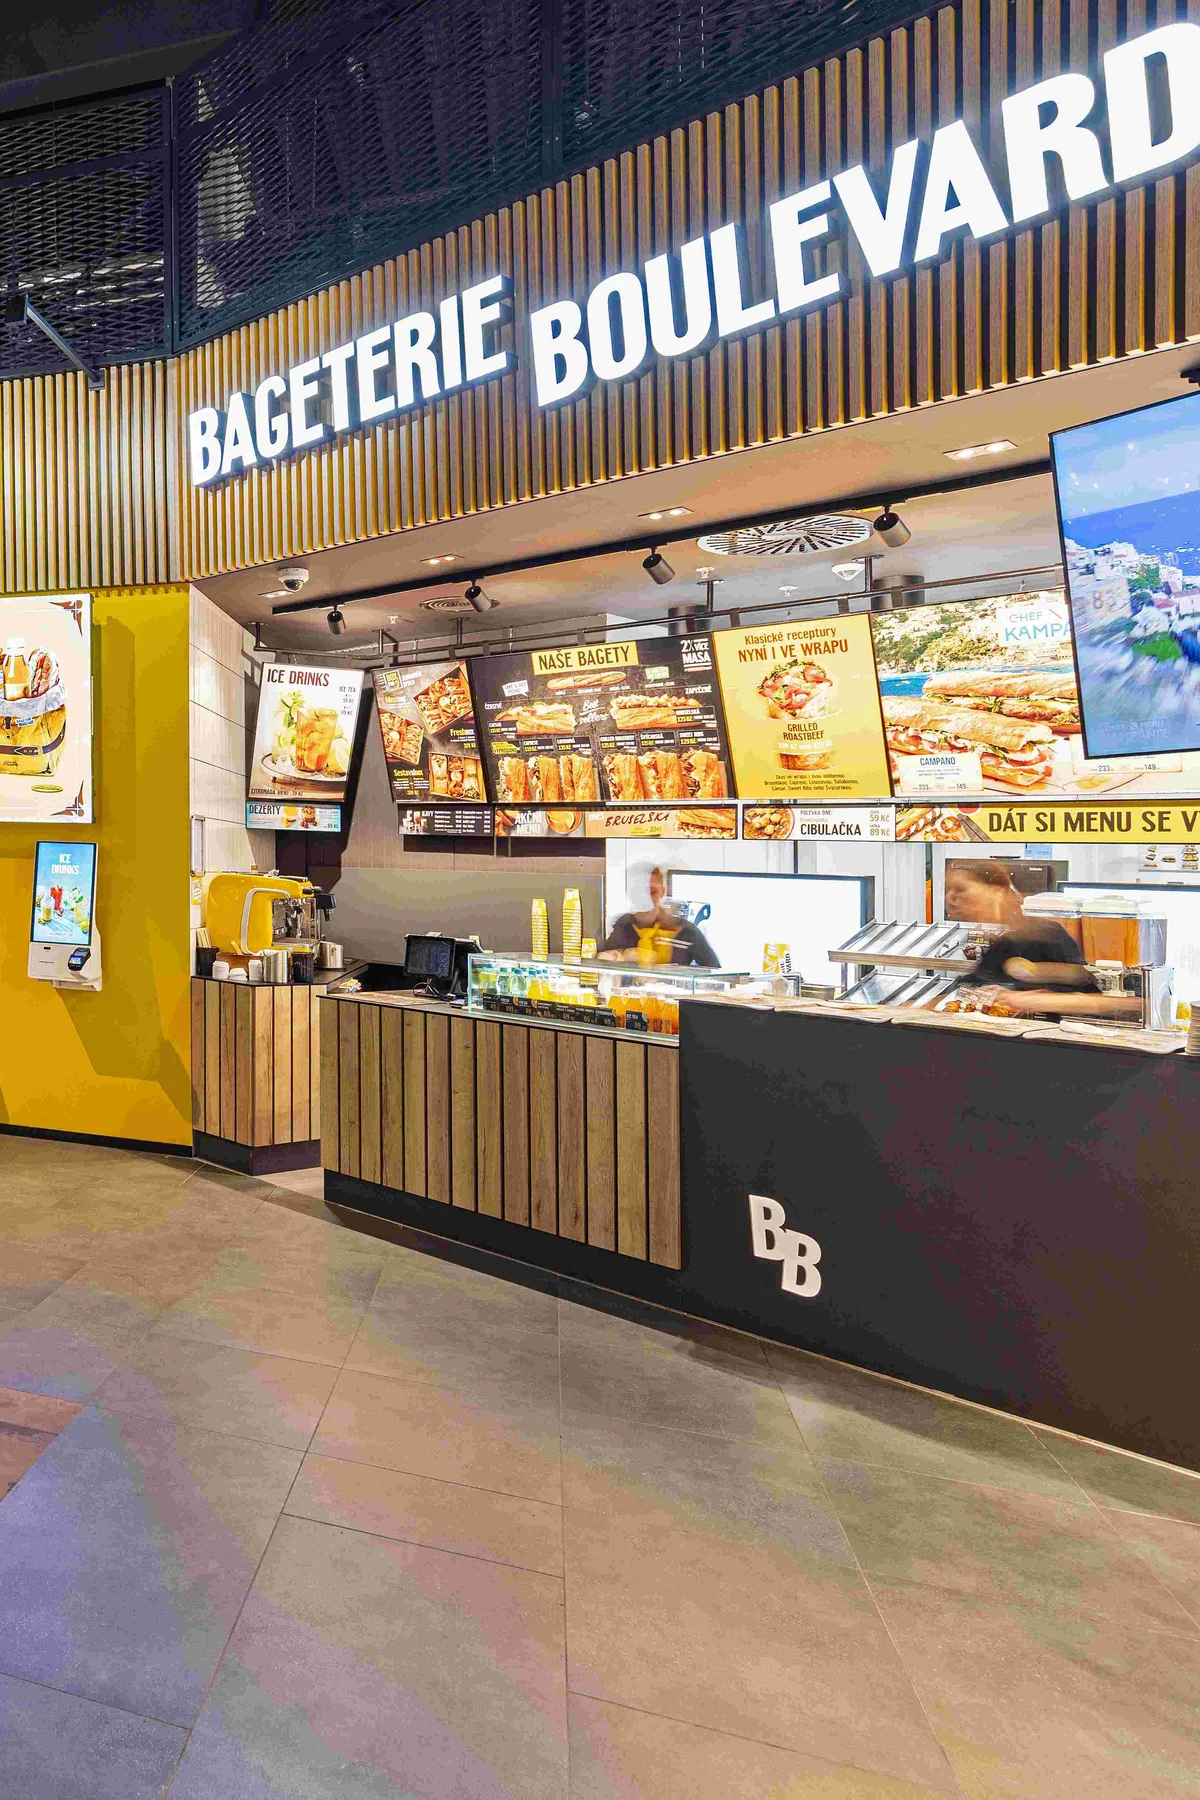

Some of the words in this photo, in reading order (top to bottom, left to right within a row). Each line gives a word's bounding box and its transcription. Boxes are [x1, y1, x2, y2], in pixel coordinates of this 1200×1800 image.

[188, 276, 510, 487] BAGETERIE
[530, 22, 1200, 407] BOULEVARD
[1009, 611, 1042, 623] CHEF
[745, 631, 784, 645] Klasické
[787, 627, 837, 640] receptury
[738, 645, 767, 662] NYNÍ
[771, 646, 776, 659] I
[780, 644, 797, 658] VE
[801, 639, 849, 656] WRAPU
[539, 649, 573, 670] NAŠE
[578, 646, 629, 666] BAGETY
[682, 652, 711, 664] MASA
[267, 668, 285, 683] ICE
[289, 670, 330, 687] DRINKS
[583, 699, 600, 711] Best
[579, 712, 608, 725] sellers
[787, 722, 818, 731] GRILLED
[783, 730, 824, 740] ROASTBEEF
[920, 757, 956, 765] CAMPANO
[249, 805, 280, 815] DEZERTY
[515, 810, 542, 824] AKČNÍ
[869, 814, 879, 822] 59
[881, 814, 890, 822] Kč
[988, 808, 1027, 832] DÁT
[1036, 812, 1055, 832] SI
[1064, 811, 1132, 832] MENU
[1142, 811, 1172, 832] SE
[517, 824, 541, 835] MENU
[800, 821, 862, 836] CIBULAČKA
[869, 828, 879, 836] 89
[881, 828, 890, 836] Kč
[60, 853, 71, 863] ICE
[51, 864, 80, 875] DRINKS
[749, 1195, 821, 1297] BB
